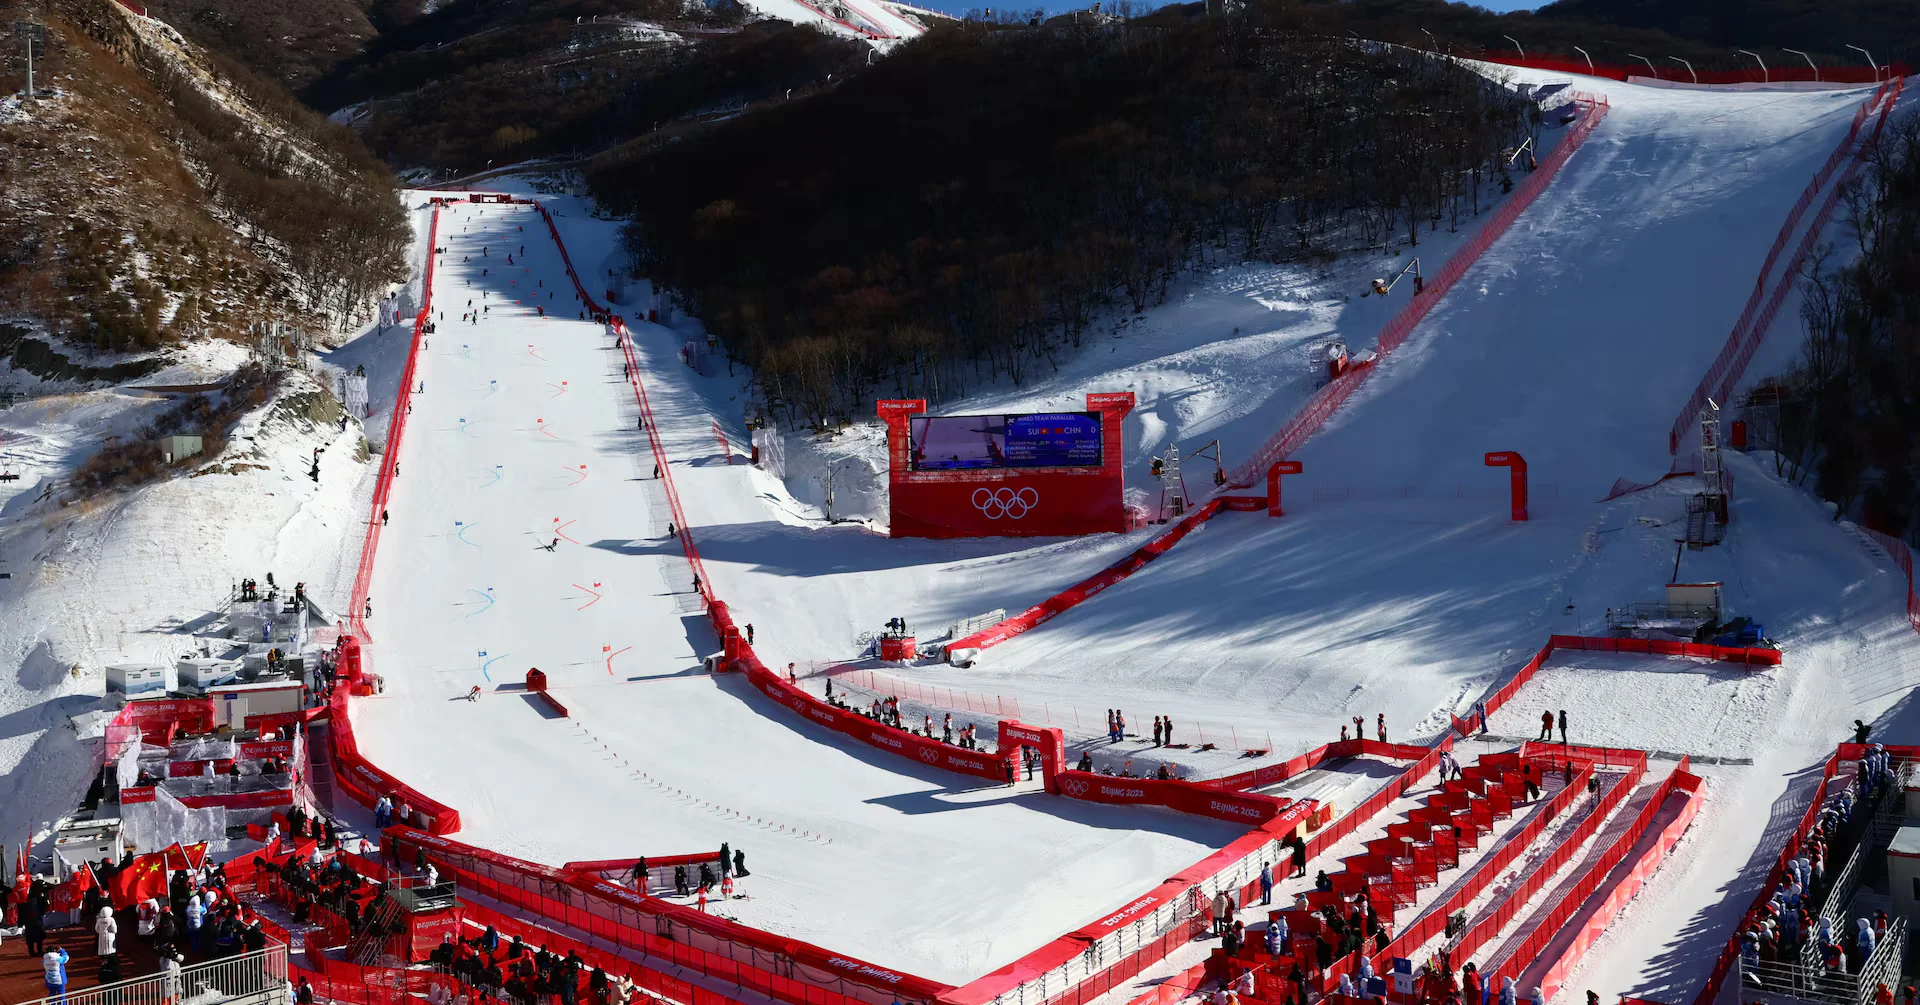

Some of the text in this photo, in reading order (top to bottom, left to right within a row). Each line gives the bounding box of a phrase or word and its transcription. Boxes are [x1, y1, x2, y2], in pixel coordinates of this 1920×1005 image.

[871, 733, 903, 748] BEIJING 2022
[1006, 728, 1041, 742] BEIJING 2022
[948, 755, 984, 770] BEIJING 2022
[1101, 786, 1144, 797] BEIJING 2022
[1210, 801, 1261, 818] BEIJING 2022
[1101, 896, 1158, 926] BEIJING 2022
[417, 920, 440, 929] BEIJING
[828, 956, 903, 984] BEIJING 2022
